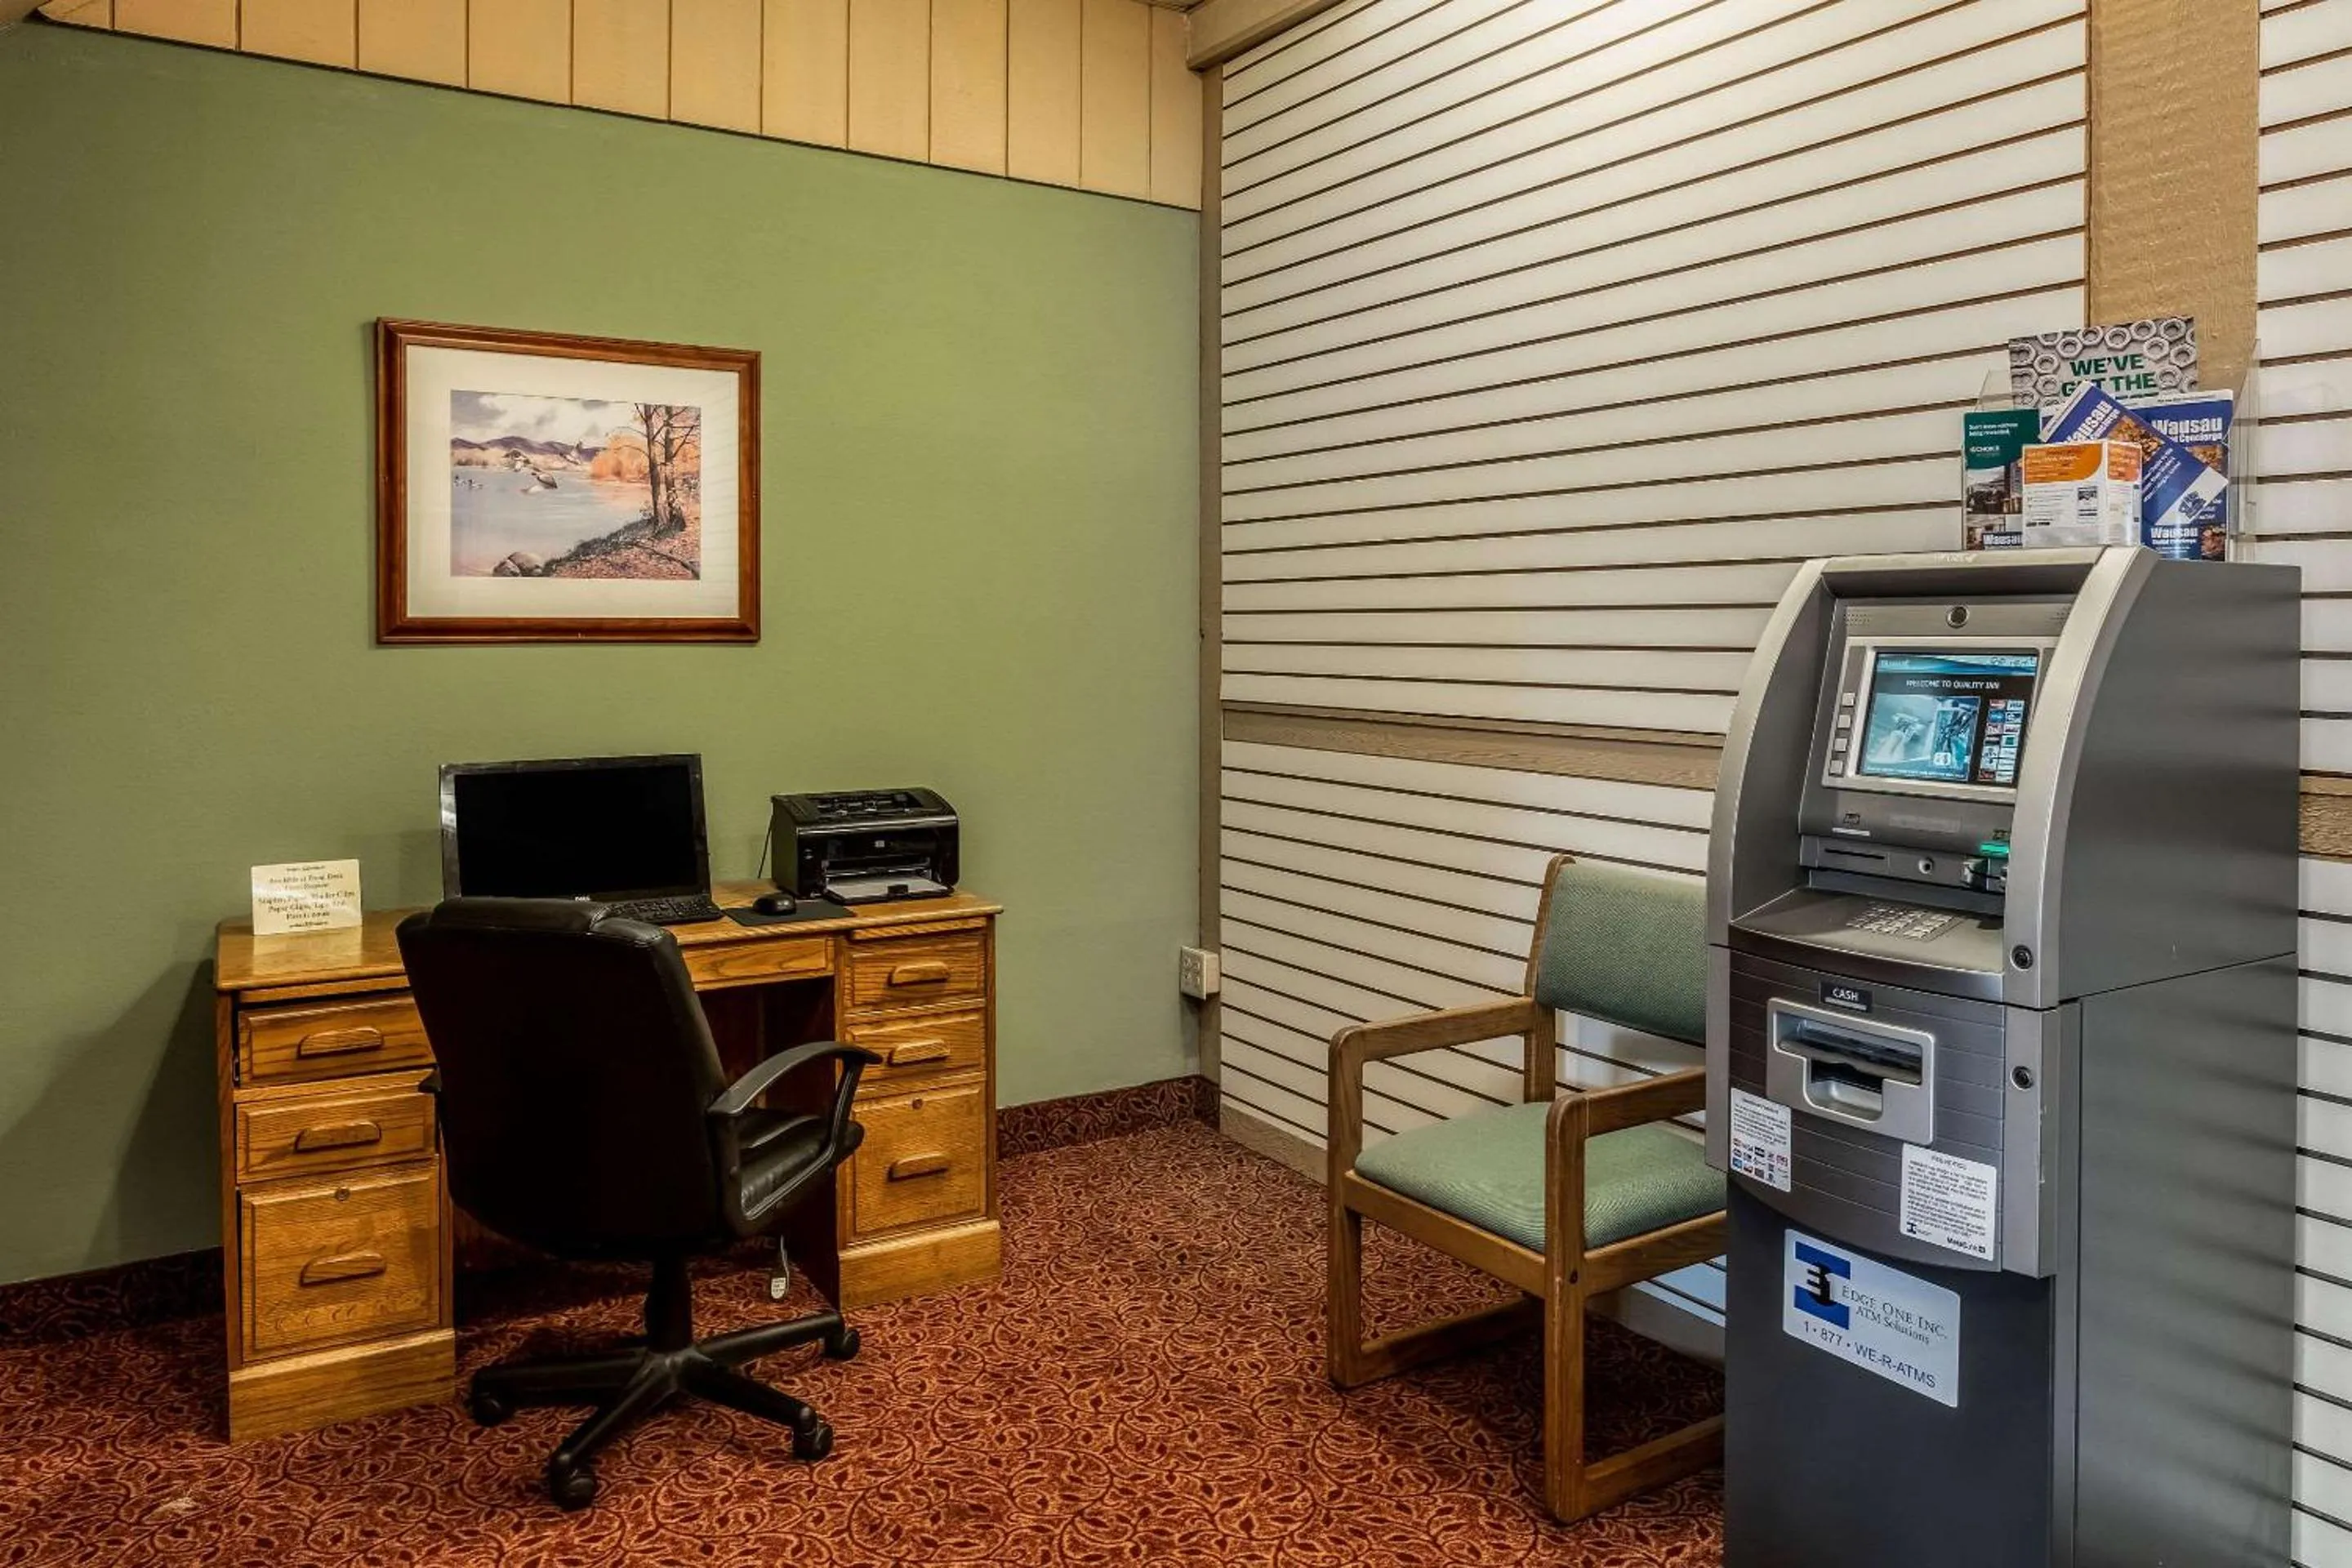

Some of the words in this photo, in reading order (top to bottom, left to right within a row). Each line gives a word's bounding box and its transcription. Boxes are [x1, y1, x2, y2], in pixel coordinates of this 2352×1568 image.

[2069, 354, 2145, 376] WE'VE
[2061, 377, 2106, 397] GT
[2109, 372, 2158, 392] THE
[1906, 679, 1940, 688] WELCOME
[1942, 679, 1952, 688] TO
[1953, 681, 1984, 690] QUALITY
[1985, 681, 2000, 689] INN
[1833, 987, 1859, 1001] CASH
[1842, 1285, 1877, 1308] EDGE
[1882, 1302, 1913, 1325] ONE
[1856, 1306, 1882, 1324] ATM
[1883, 1316, 1930, 1345] Solutions
[1854, 1342, 1936, 1388] WE-R-ATMS
